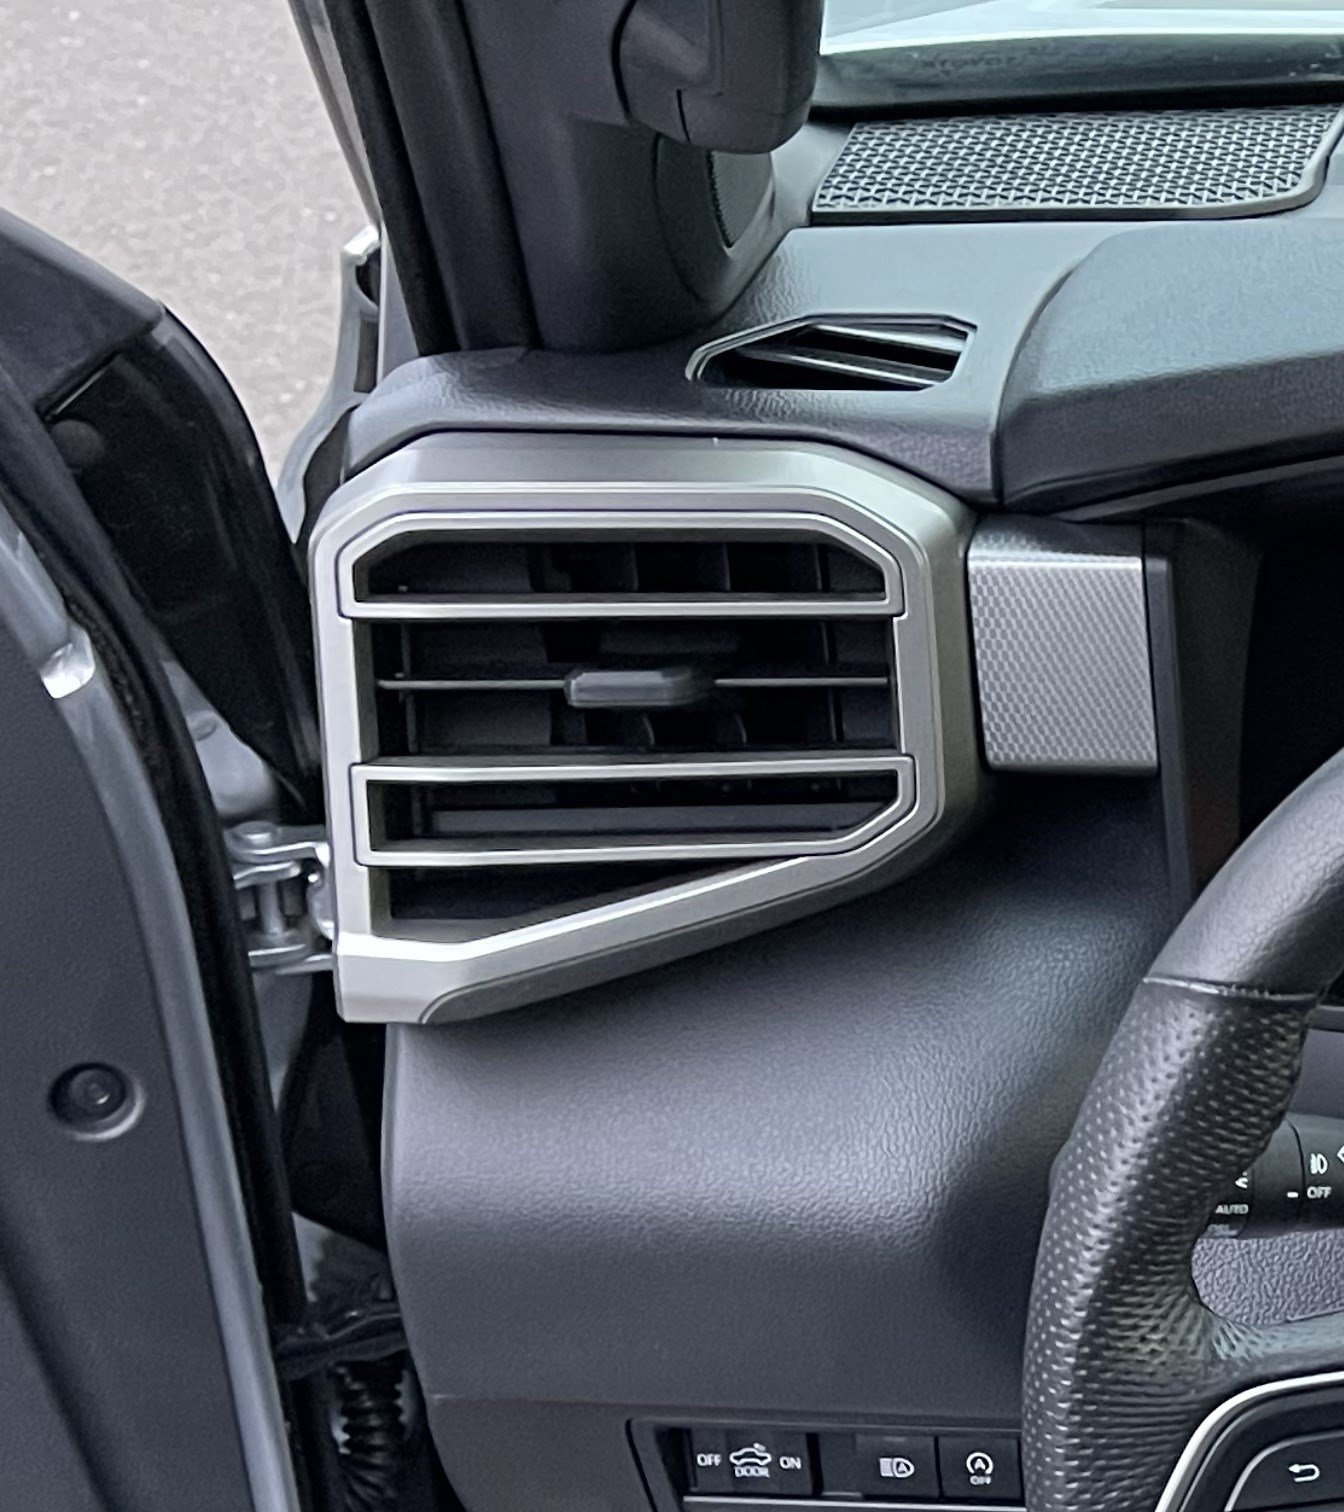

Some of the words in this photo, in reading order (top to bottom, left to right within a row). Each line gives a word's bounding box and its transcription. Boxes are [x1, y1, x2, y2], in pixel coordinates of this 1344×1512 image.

[1307, 1187, 1331, 1198] OFF
[1216, 1204, 1248, 1214] AUTO
[697, 1454, 721, 1466] OFF
[780, 1457, 801, 1469] ON
